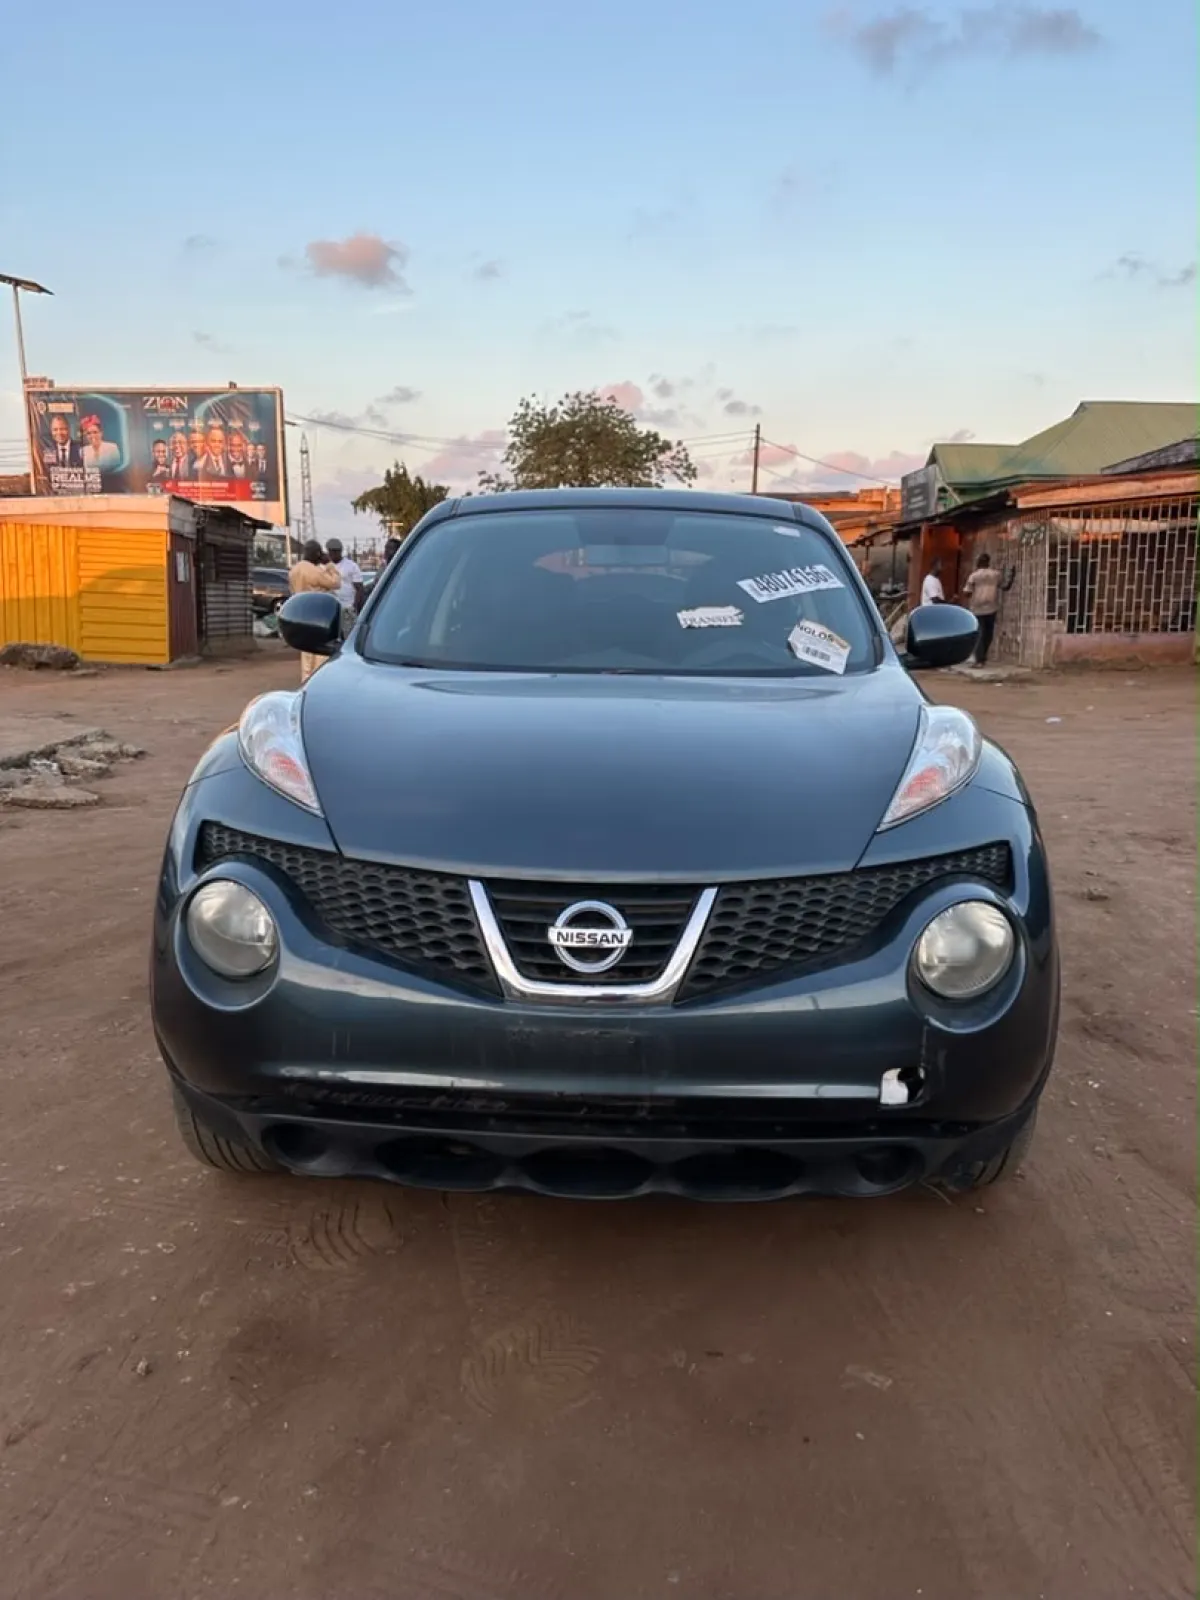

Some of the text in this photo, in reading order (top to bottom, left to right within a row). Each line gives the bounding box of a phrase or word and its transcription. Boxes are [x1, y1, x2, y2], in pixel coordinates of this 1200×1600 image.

[143, 396, 188, 409] ZION
[51, 473, 101, 482] REALMS
[556, 931, 624, 945] NISSAN
